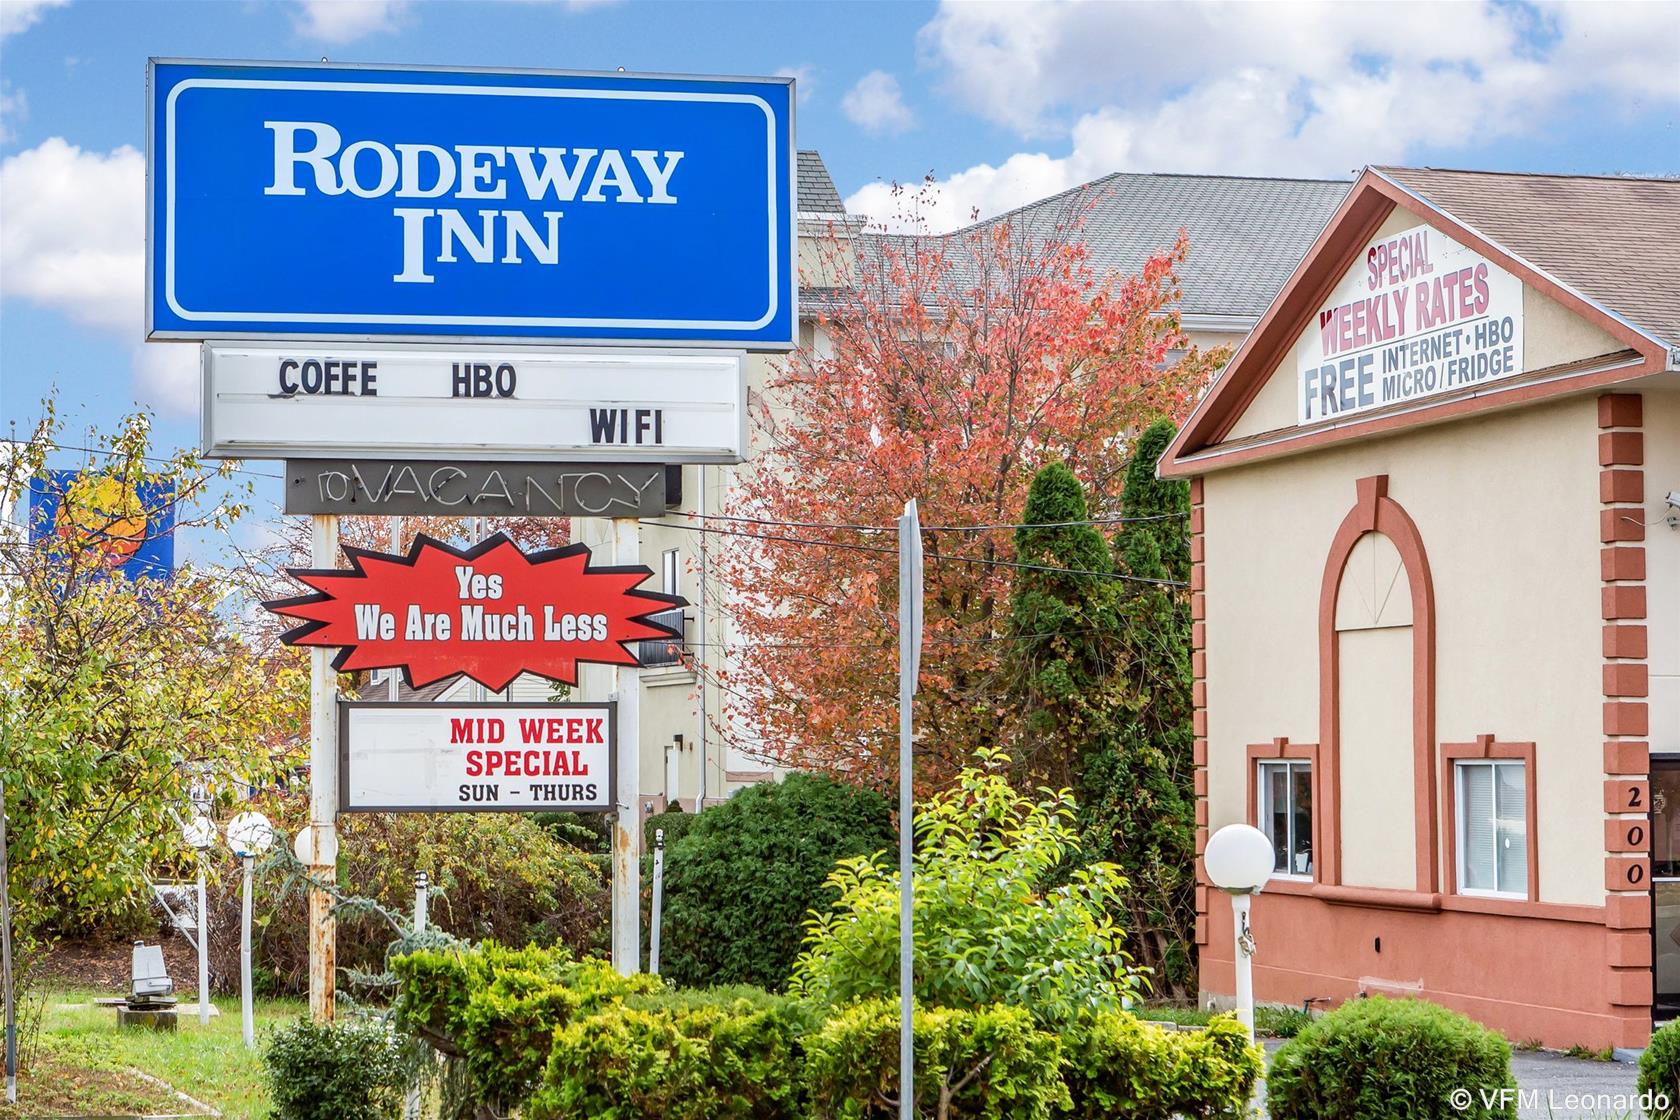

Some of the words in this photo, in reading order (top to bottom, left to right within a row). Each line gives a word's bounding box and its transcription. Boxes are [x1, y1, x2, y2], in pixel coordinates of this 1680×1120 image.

[264, 121, 684, 204] RODEWAY
[393, 208, 563, 283] INN
[1367, 231, 1433, 291] SPECIAL
[1320, 287, 1409, 356] WEEKLY
[1416, 263, 1489, 330] RATES
[279, 359, 377, 395] COFFE
[452, 362, 516, 397] HBO
[1305, 353, 1374, 419] FREE
[590, 409, 662, 444] WIFI
[352, 464, 659, 513] VACANCY
[455, 566, 503, 600] Yes
[353, 604, 396, 641] We
[404, 605, 452, 641] Are
[459, 605, 535, 642] Much
[543, 605, 608, 642] Less
[451, 718, 505, 744] MID
[519, 718, 604, 744] WEEK
[466, 750, 589, 777] SPECIAL
[458, 784, 499, 802] SUN
[529, 784, 597, 802] THURS
